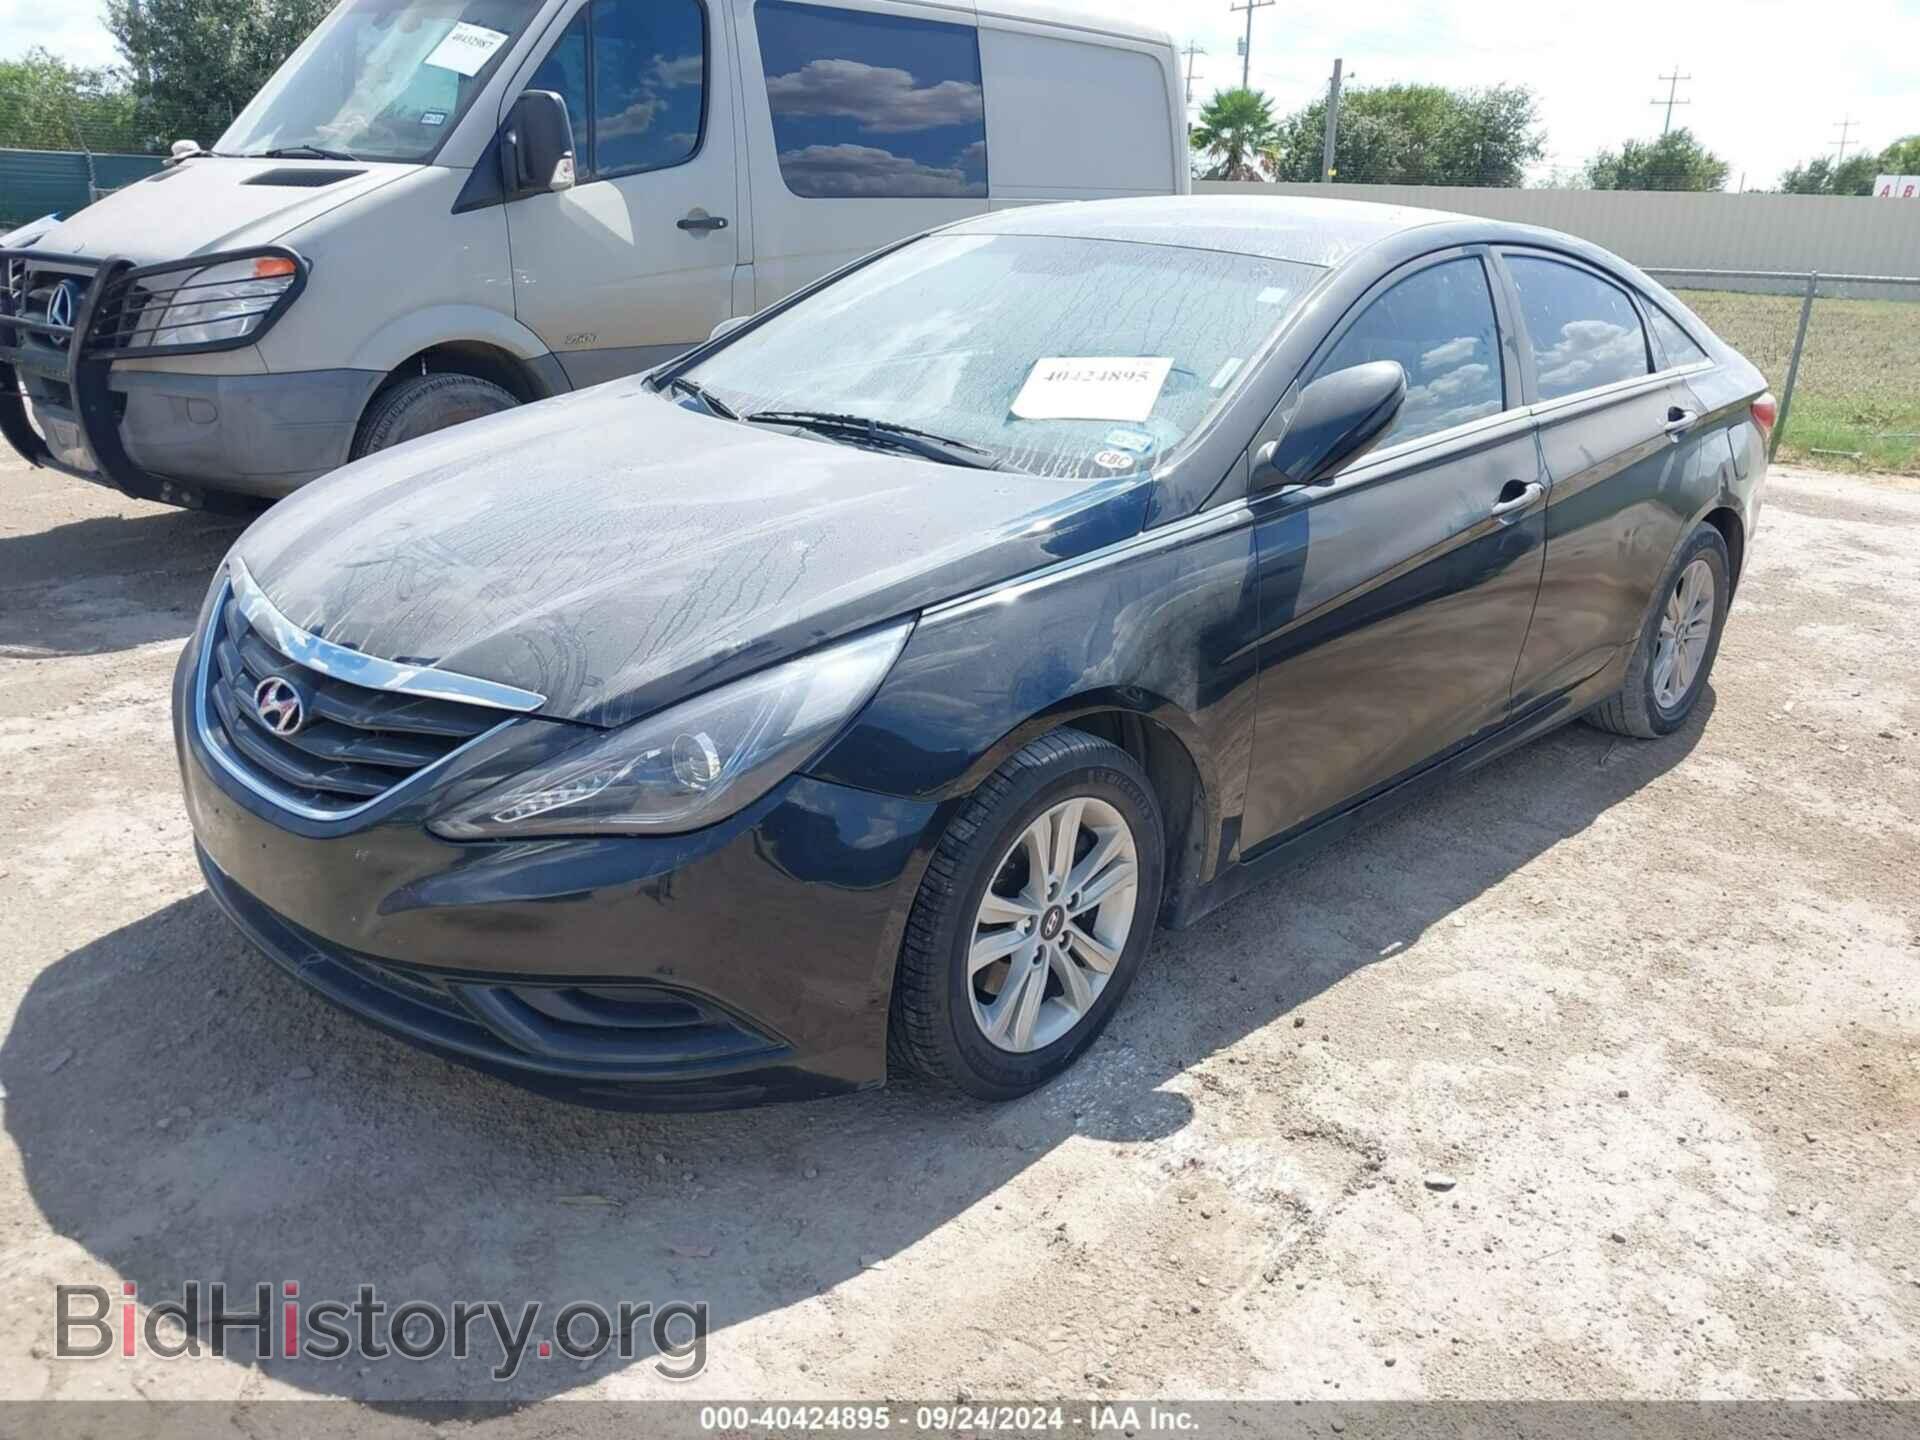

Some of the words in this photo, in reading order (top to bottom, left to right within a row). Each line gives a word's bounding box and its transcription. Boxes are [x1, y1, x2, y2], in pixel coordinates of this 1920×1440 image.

[1880, 184, 1891, 198] A
[1903, 184, 1915, 198] B
[1043, 369, 1152, 383] 40424895
